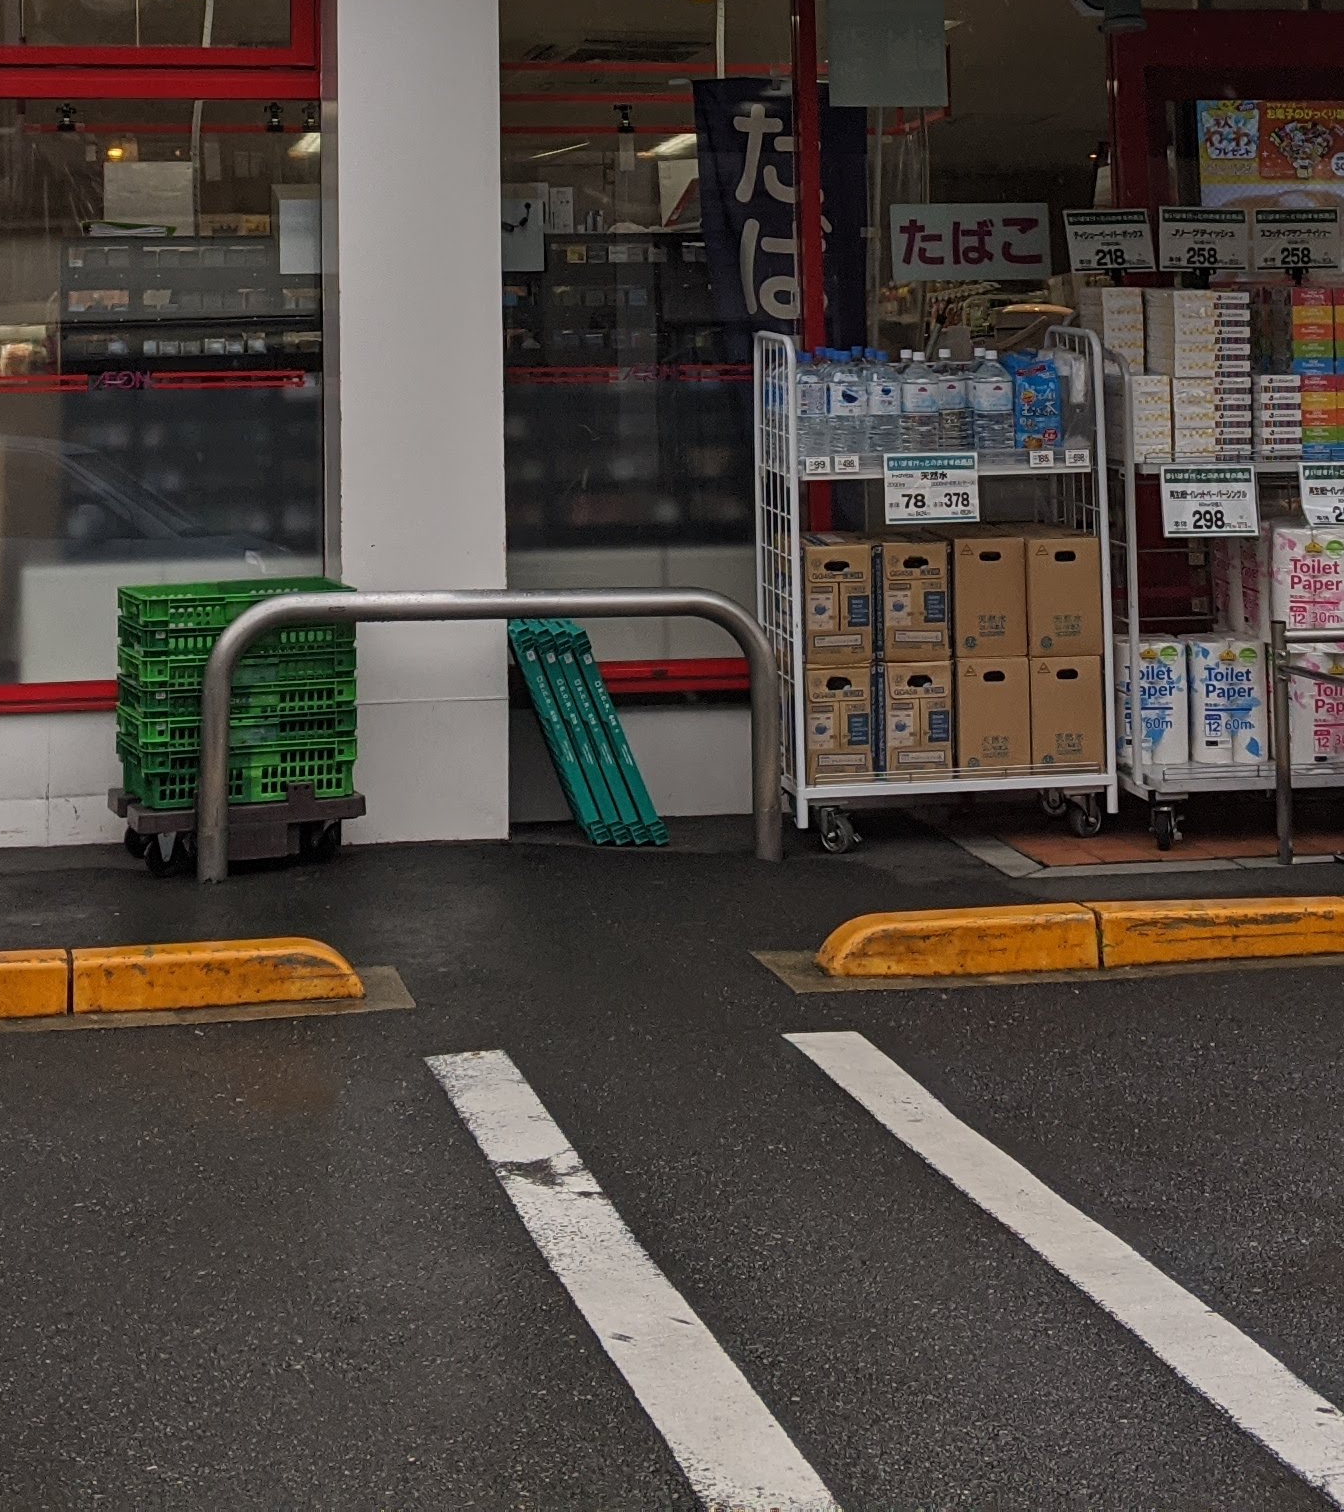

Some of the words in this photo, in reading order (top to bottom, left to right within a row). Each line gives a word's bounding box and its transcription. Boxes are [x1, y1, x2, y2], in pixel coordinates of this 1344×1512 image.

[899, 217, 1043, 265] たばこ
[1095, 248, 1126, 266] 218
[1186, 247, 1217, 265] 258
[1280, 247, 1311, 265] 258
[920, 471, 948, 481] 天然水
[901, 493, 927, 509] 78
[943, 492, 970, 508] 378
[1192, 510, 1225, 530] 298
[1289, 558, 1340, 576] Toilet
[1290, 575, 1343, 593] Paper
[1291, 614, 1307, 624] 12
[1311, 611, 1343, 624] 30m
[1204, 667, 1252, 682] Toilet
[1205, 683, 1254, 701] Paper
[1145, 717, 1174, 730] 60m
[1207, 721, 1221, 733] 12
[1225, 718, 1253, 731] 60m
[1315, 736, 1330, 748] 12
